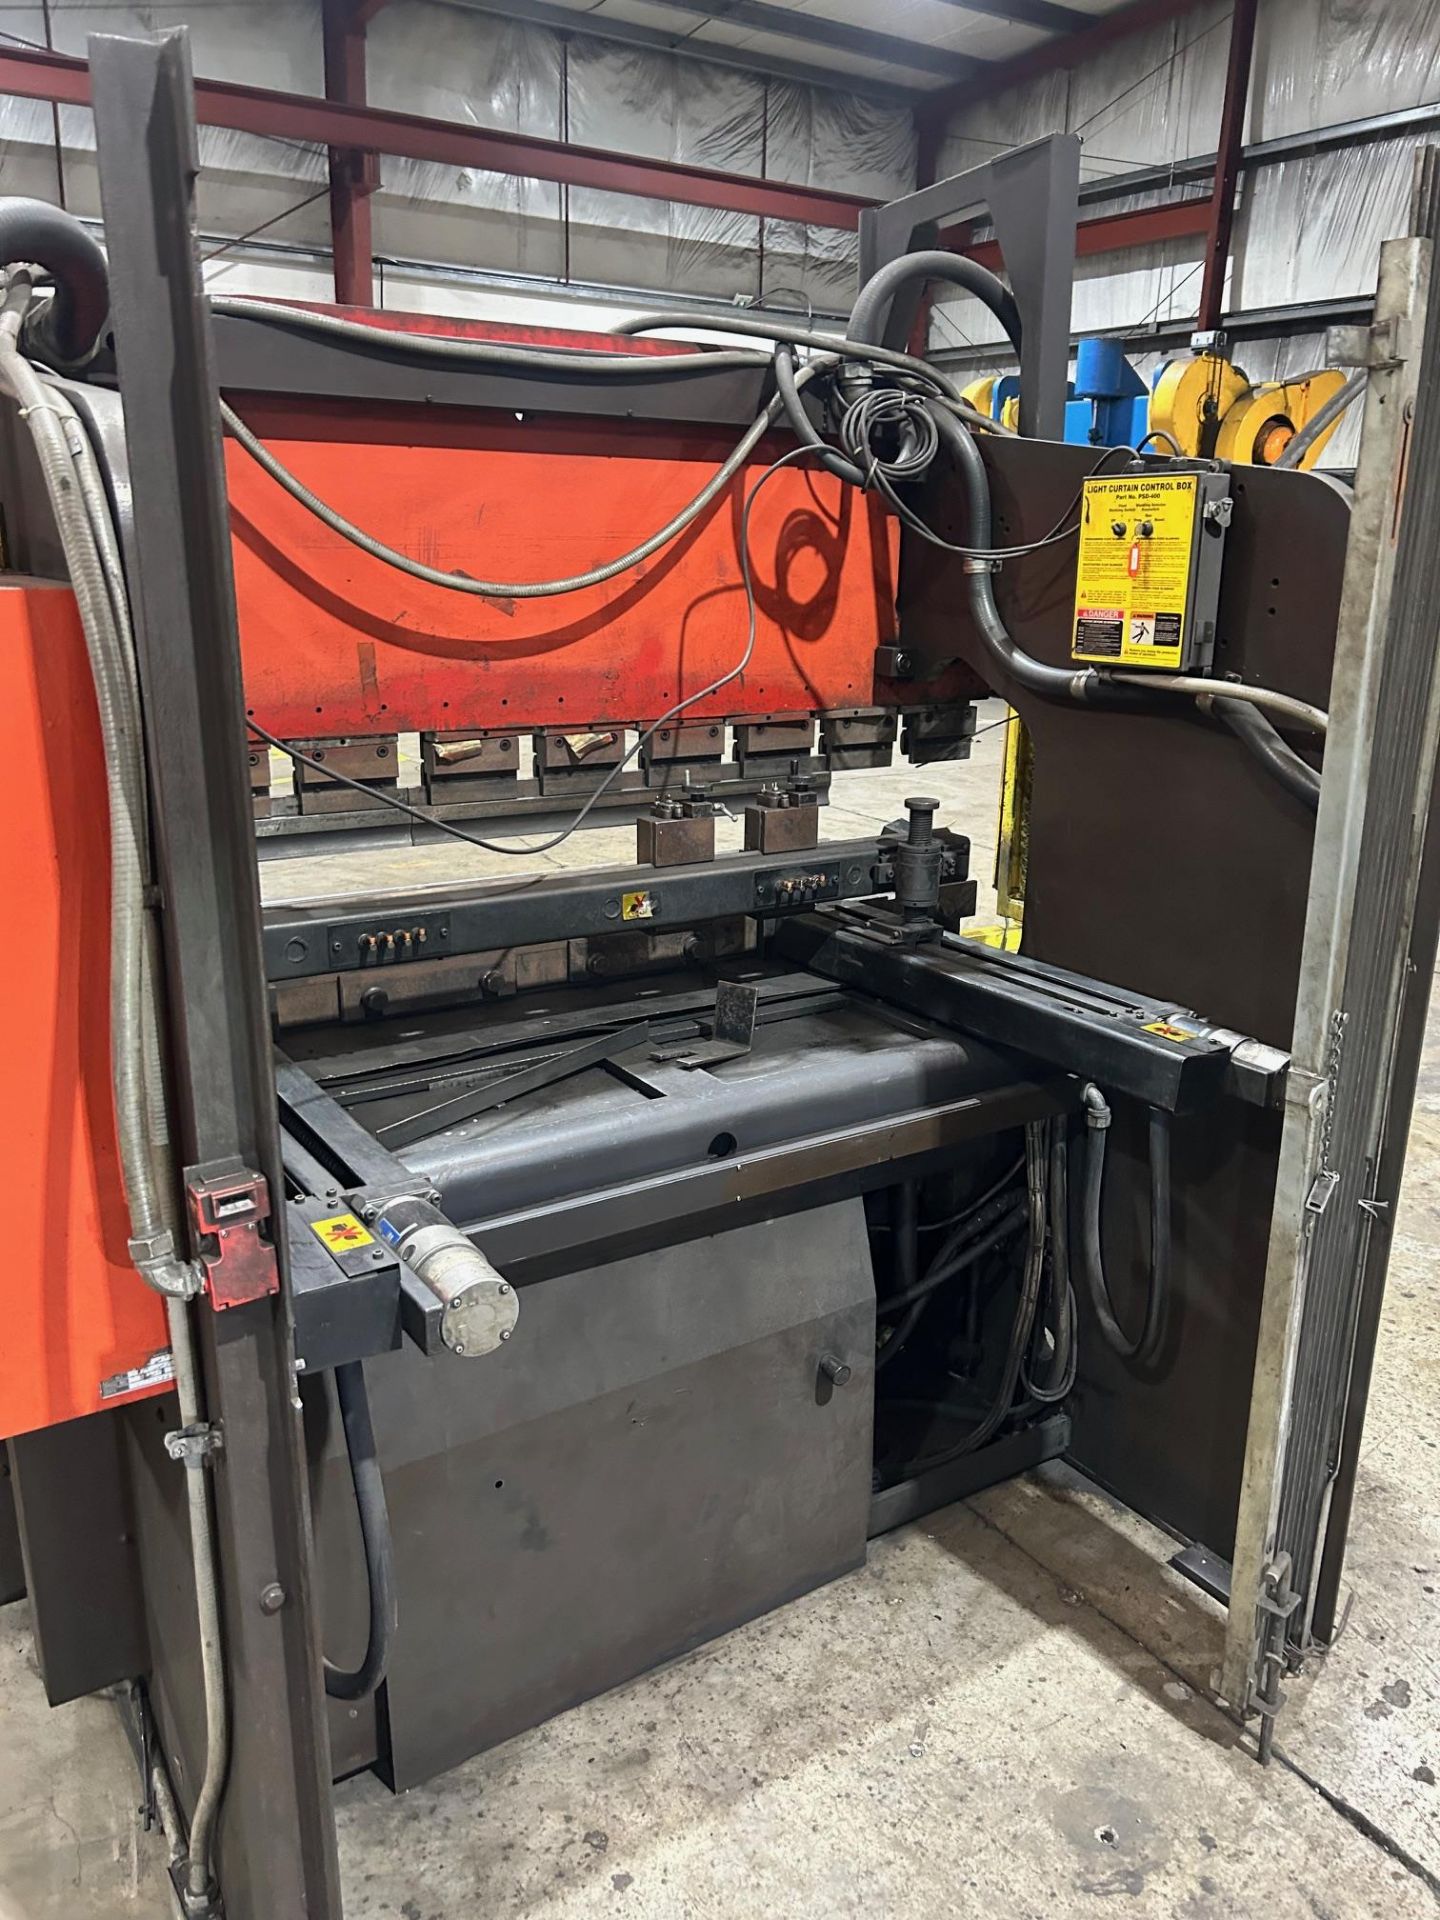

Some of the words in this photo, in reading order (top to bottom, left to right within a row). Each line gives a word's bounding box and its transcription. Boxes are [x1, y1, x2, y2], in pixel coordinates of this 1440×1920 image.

[1087, 485, 1107, 494] LIGHT
[1109, 483, 1139, 493] CURTAIN
[1141, 482, 1174, 492] CONTROL
[1177, 481, 1192, 490] BOX
[1088, 610, 1119, 619] DANGER
